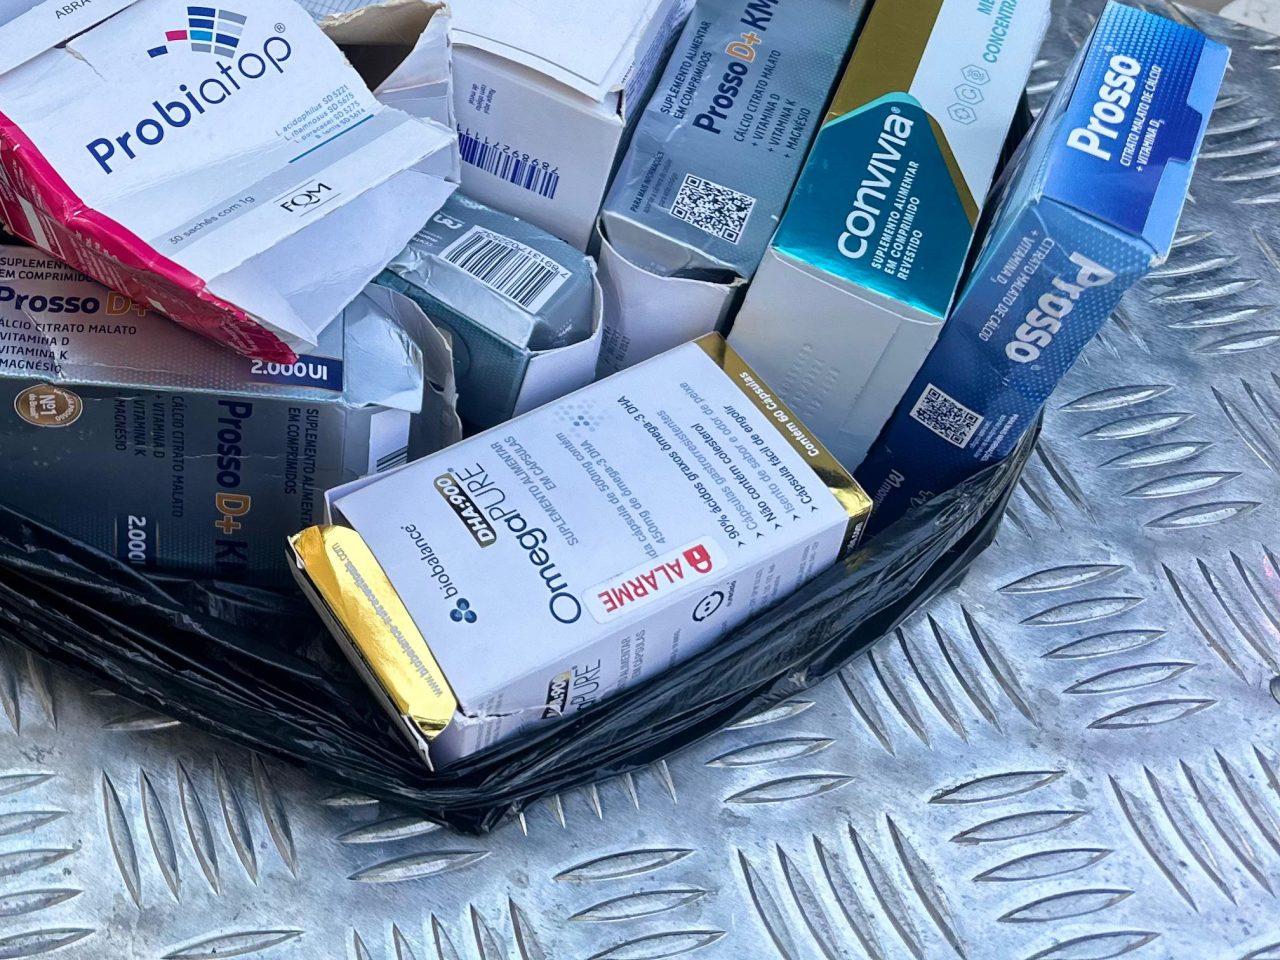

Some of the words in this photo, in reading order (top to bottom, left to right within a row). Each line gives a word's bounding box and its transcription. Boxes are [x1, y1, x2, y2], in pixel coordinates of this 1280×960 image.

[660, 59, 692, 115] SUPLEMENTO
[685, 18, 712, 62] ALIMENTAR
[679, 49, 712, 106] COMPRIMIDOS
[692, 62, 748, 135] Prosso
[725, 31, 761, 64] D+
[85, 32, 292, 175] Probiatop
[282, 103, 323, 132] acidophilus
[332, 84, 349, 98] 5221
[337, 92, 354, 107] 5675
[731, 111, 753, 142] CÁLCIO
[746, 78, 768, 113] CITRATO
[760, 49, 781, 80] MALATO
[1066, 55, 1141, 161] Prosso
[1119, 132, 1140, 166] CITRATO
[1130, 101, 1149, 133] MALATO
[1142, 62, 1162, 91] CÁLCIO
[752, 98, 778, 141] VITAMINA
[768, 104, 794, 147] VITAMINA
[783, 105, 810, 150] MAGNÉSIO
[1136, 127, 1157, 166] VITAMINA
[280, 182, 333, 213] FQM
[870, 209, 901, 269] SUPLEMENTO
[892, 160, 918, 210] ALIMENTAR
[182, 213, 218, 238] sachês
[218, 205, 240, 223] com
[889, 196, 920, 259] COMPRIMIDO
[897, 229, 923, 281] REVESTIDO
[997, 235, 1036, 277] VITAMINA
[1022, 236, 1055, 275] CITRATO
[1001, 272, 1031, 307] MALATO
[1005, 251, 1117, 364] Prosso
[0, 332, 57, 346] VITAMINA
[35, 322, 84, 333] CITRATO
[88, 325, 136, 335] MALATO
[977, 313, 1003, 343] CÁLCIO
[616, 394, 638, 416] DHA
[678, 379, 703, 406] peixe
[737, 369, 779, 412] Cápsulas
[115, 399, 127, 451] MAGNÉSIO
[133, 399, 145, 448] VITAMINA
[152, 403, 165, 450] VITAMINA
[172, 396, 184, 431] CÁLCIO
[288, 407, 301, 422] EM
[632, 410, 672, 453] ômega-3
[709, 413, 731, 437] odor
[722, 401, 754, 436] engolir
[172, 432, 184, 472] CITRATO
[216, 400, 253, 488] Prosso
[285, 423, 299, 495] COMPRIMIDOS
[303, 408, 319, 474] SUPLEMENTO
[502, 434, 545, 478] CÁPSULAS
[553, 430, 585, 464] contém
[580, 438, 600, 460] DHA
[655, 405, 726, 488] gastrorresistentes
[690, 421, 731, 467] colesterol
[732, 442, 760, 471] sabor
[759, 444, 781, 468] fácil
[783, 420, 820, 459] Contém
[489, 438, 533, 487] ALIMENTAR
[580, 459, 611, 492] 500mg
[593, 454, 633, 500] ômega-3
[666, 448, 699, 483] graxos
[726, 463, 761, 502] contém
[172, 474, 184, 518] MALATO
[689, 480, 722, 516] ácidos
[765, 481, 795, 514] Isento
[775, 464, 814, 506] Cápsula
[215, 492, 251, 534] D+
[436, 477, 496, 542] DHA:900
[524, 483, 580, 547] SUPLEMENTO
[613, 505, 649, 543] cápsula
[635, 507, 669, 547] 450mg
[714, 513, 740, 540] 90%
[718, 484, 759, 531] Cápsulas
[754, 499, 778, 524] Não
[405, 523, 458, 600] biobalance
[455, 463, 582, 624] OmegaPURE
[598, 558, 685, 614] ALARME
